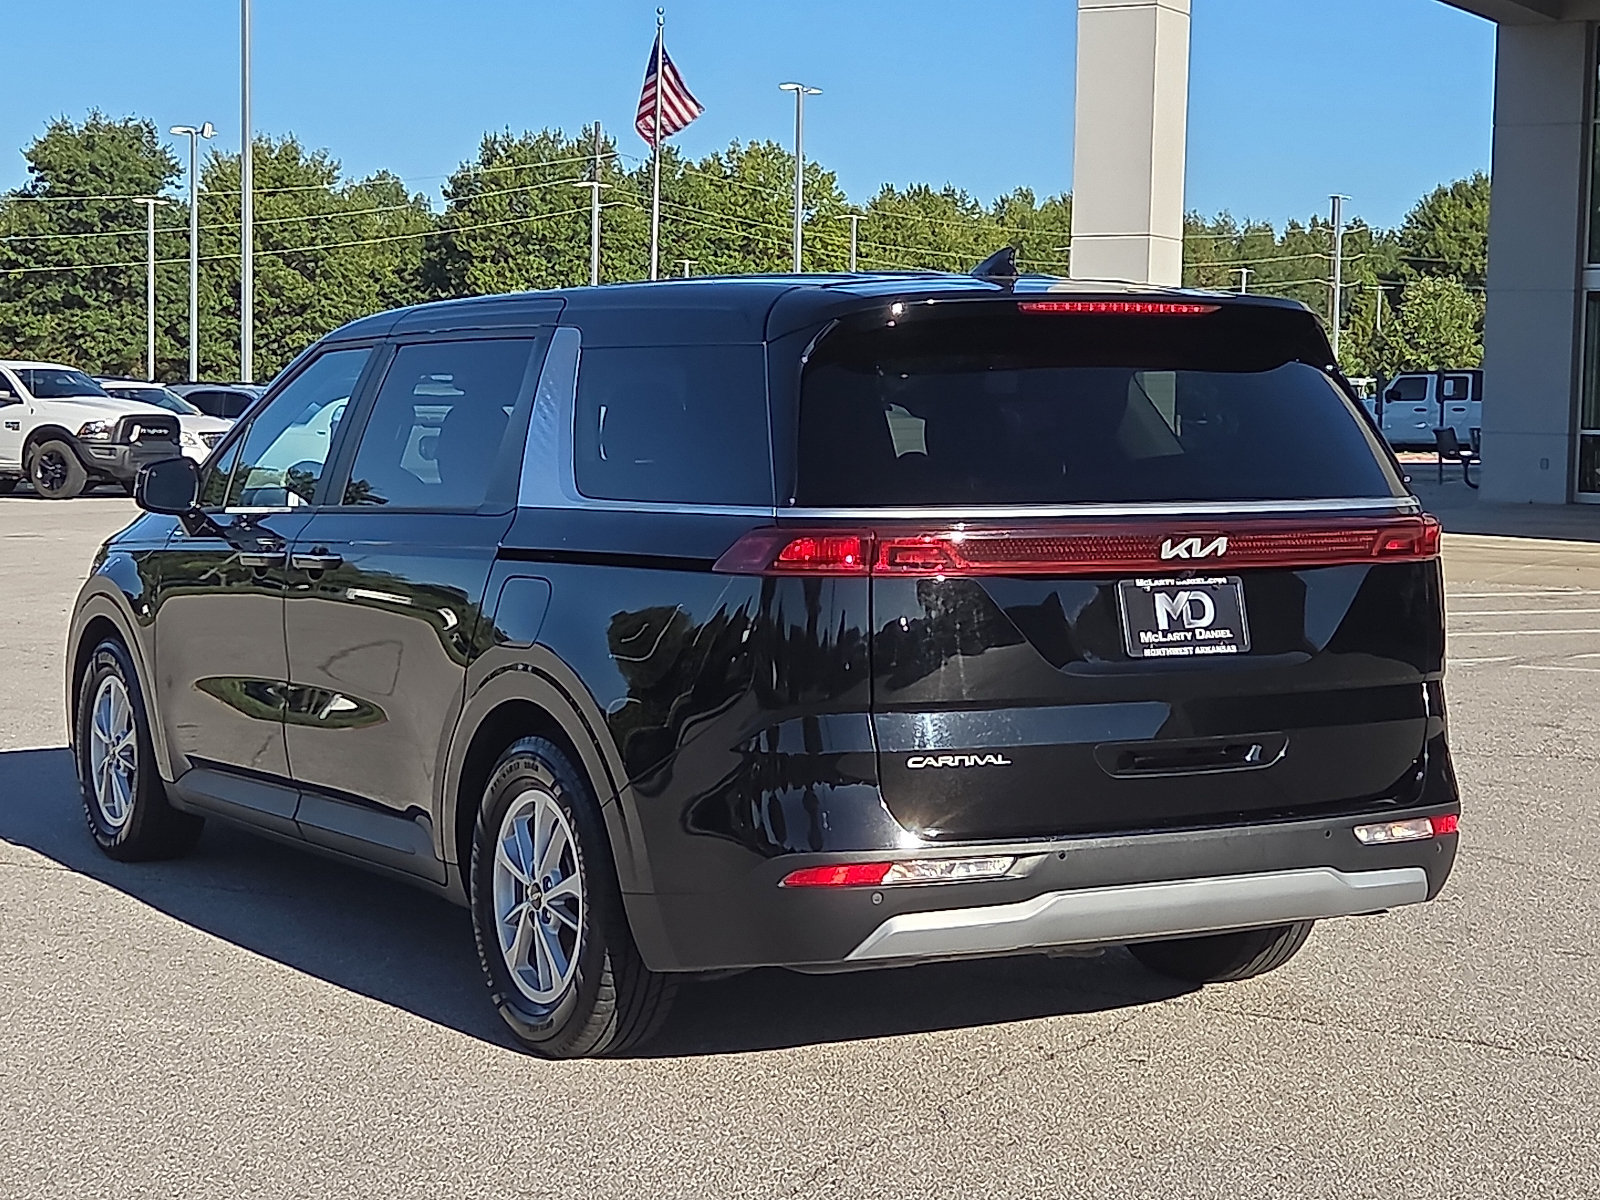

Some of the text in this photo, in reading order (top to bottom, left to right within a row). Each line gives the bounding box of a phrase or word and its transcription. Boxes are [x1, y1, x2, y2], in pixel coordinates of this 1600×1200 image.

[1160, 537, 1228, 560] KIA
[1154, 590, 1215, 630] MD
[1143, 644, 1237, 657] NORTHWEST ARKANSAS
[906, 753, 1013, 769] CARNIVAL
